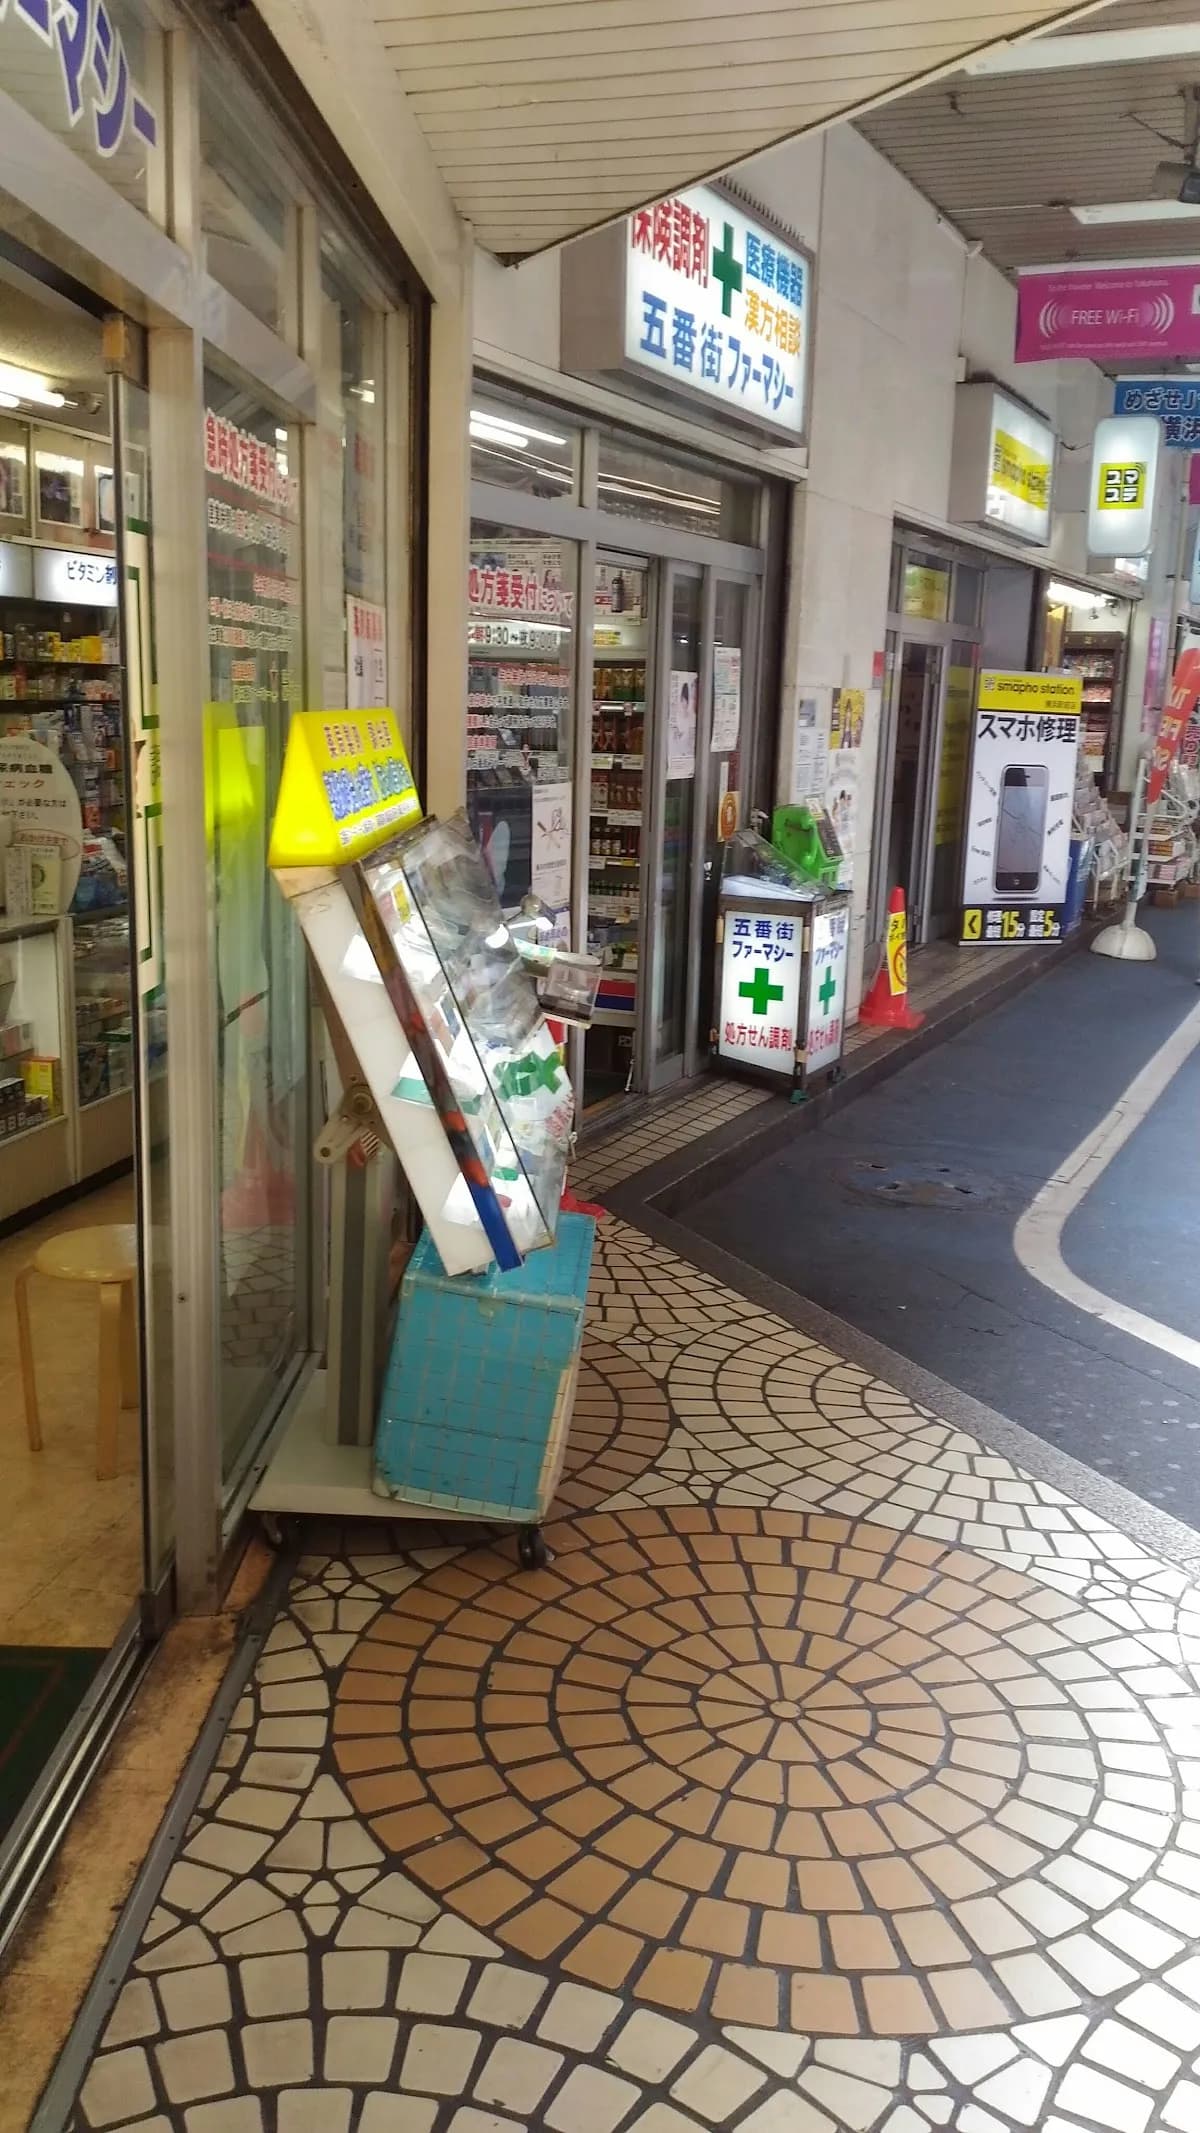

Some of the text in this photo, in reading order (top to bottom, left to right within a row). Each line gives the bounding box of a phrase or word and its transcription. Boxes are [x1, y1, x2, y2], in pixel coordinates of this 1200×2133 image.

[745, 230, 803, 308] 医療機器
[744, 288, 802, 358] 漢方相談
[1071, 307, 1140, 325] FREE Wi-Fi
[1123, 387, 1200, 411] めざせJ
[997, 682, 1039, 695] smapho
[1040, 683, 1075, 696] station
[978, 713, 1077, 743] スマホ修理
[733, 917, 795, 941] 五番街
[732, 940, 795, 963] ファーマシー
[724, 1021, 793, 1051] 処方せん調剤
